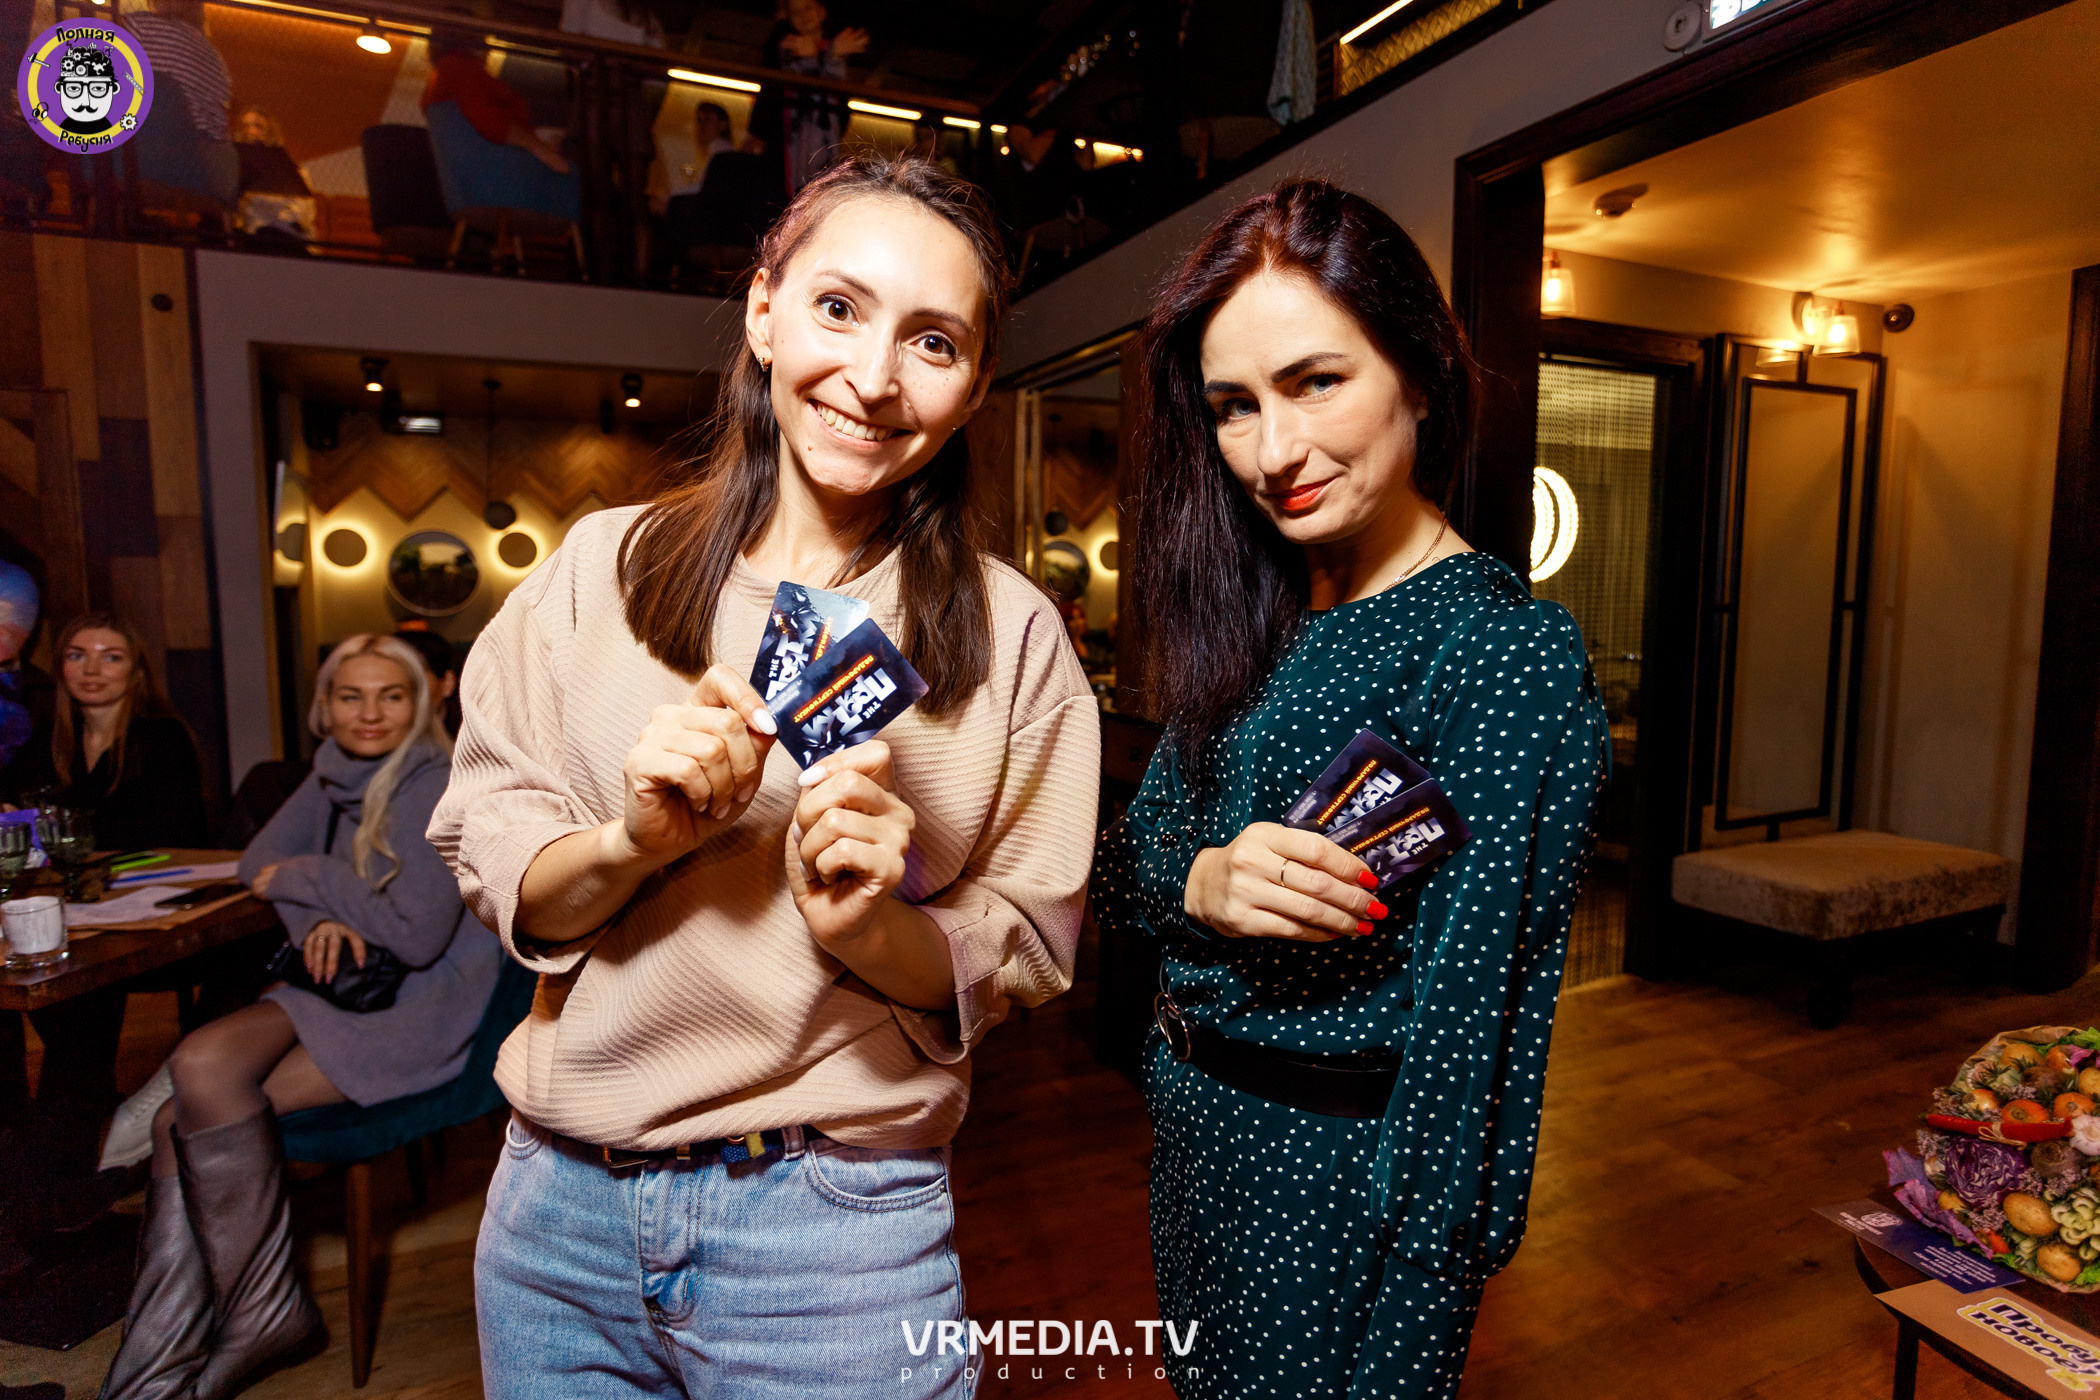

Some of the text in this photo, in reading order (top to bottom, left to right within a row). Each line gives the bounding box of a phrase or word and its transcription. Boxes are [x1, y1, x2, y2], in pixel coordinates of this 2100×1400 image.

[768, 658, 780, 678] THE
[832, 655, 874, 691] ПОДАРОЧНЫЙ
[794, 688, 834, 723] СЕРТИФИКАТ
[862, 700, 882, 719] THE
[1344, 760, 1377, 794] ПОДАРОЧНЫЙ
[1317, 793, 1347, 825] СЕРТИФИКАТ
[1388, 807, 1430, 832] ПОДАРОЧНЫЙ
[1350, 830, 1389, 853] СЕРТИФИКАТ
[1411, 842, 1429, 855] THE
[1989, 1304, 2100, 1370] Пробу
